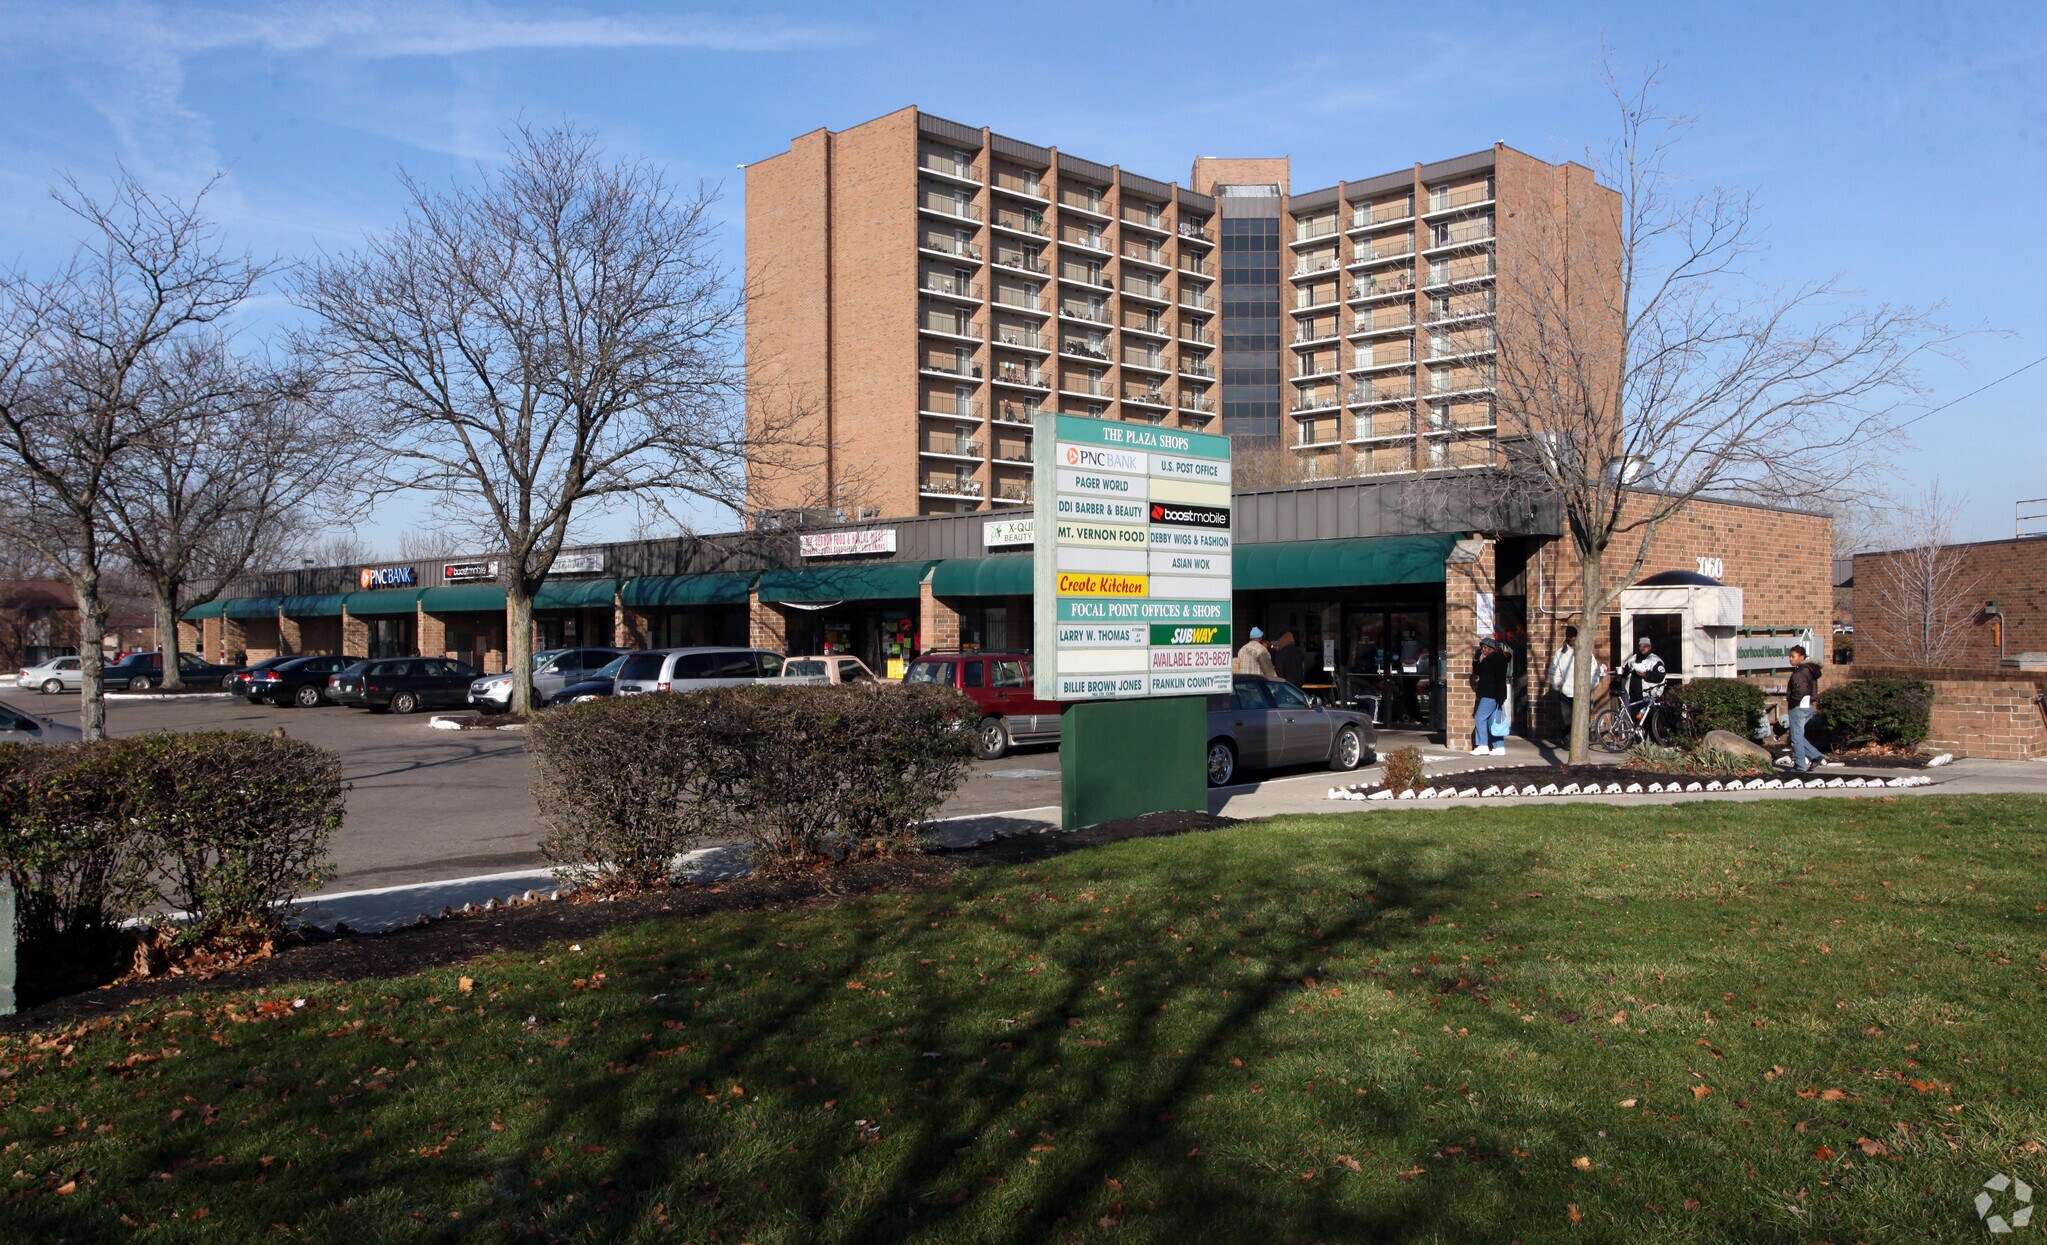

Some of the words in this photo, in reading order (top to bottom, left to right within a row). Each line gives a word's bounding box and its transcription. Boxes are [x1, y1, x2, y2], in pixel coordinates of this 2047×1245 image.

[1103, 428, 1123, 442] THE
[1126, 430, 1157, 446] PLAZA
[1160, 434, 1188, 450] SHOPS
[1162, 460, 1174, 472] U.S.
[1176, 462, 1194, 474] POST
[1195, 464, 1218, 476] OFFICE
[1076, 476, 1100, 490] PAGER
[1102, 478, 1128, 492] WORLD
[1059, 500, 1072, 512] DDI
[1076, 502, 1104, 515] BARBER
[1107, 504, 1112, 516] &
[1116, 505, 1142, 518] BEAUTY
[1004, 533, 1032, 542] BEAUTY
[1058, 527, 1074, 538] MT.
[1077, 528, 1117, 541] VERNON
[1120, 530, 1144, 542] FOOD
[1151, 532, 1171, 544] DEBBY
[1174, 533, 1191, 545] WIGS
[1194, 535, 1198, 546] &
[1200, 535, 1228, 547] FASHION
[1172, 558, 1192, 569] ASIAN
[1194, 559, 1210, 570] WOK
[1060, 575, 1096, 592] Creole
[1100, 577, 1142, 593] Kitchen
[1072, 603, 1106, 617] FOCAL
[1108, 604, 1138, 617] POINT
[1142, 604, 1180, 617] OFFICES
[1182, 605, 1190, 617] &
[1192, 605, 1221, 618] SHOPS
[1060, 630, 1084, 641] LARRY
[1086, 630, 1095, 641] W.
[1098, 630, 1130, 641] THOMAS
[1171, 627, 1218, 644] SUBWAY
[1153, 652, 1192, 667] AVAILABLE
[1195, 652, 1230, 666] 253-8627
[1064, 681, 1085, 693] BILLIE
[1088, 680, 1116, 692] BROWN
[1118, 680, 1142, 691] JONES
[1152, 678, 1185, 689] FRANKLIN
[1187, 677, 1215, 687] COUNTY
